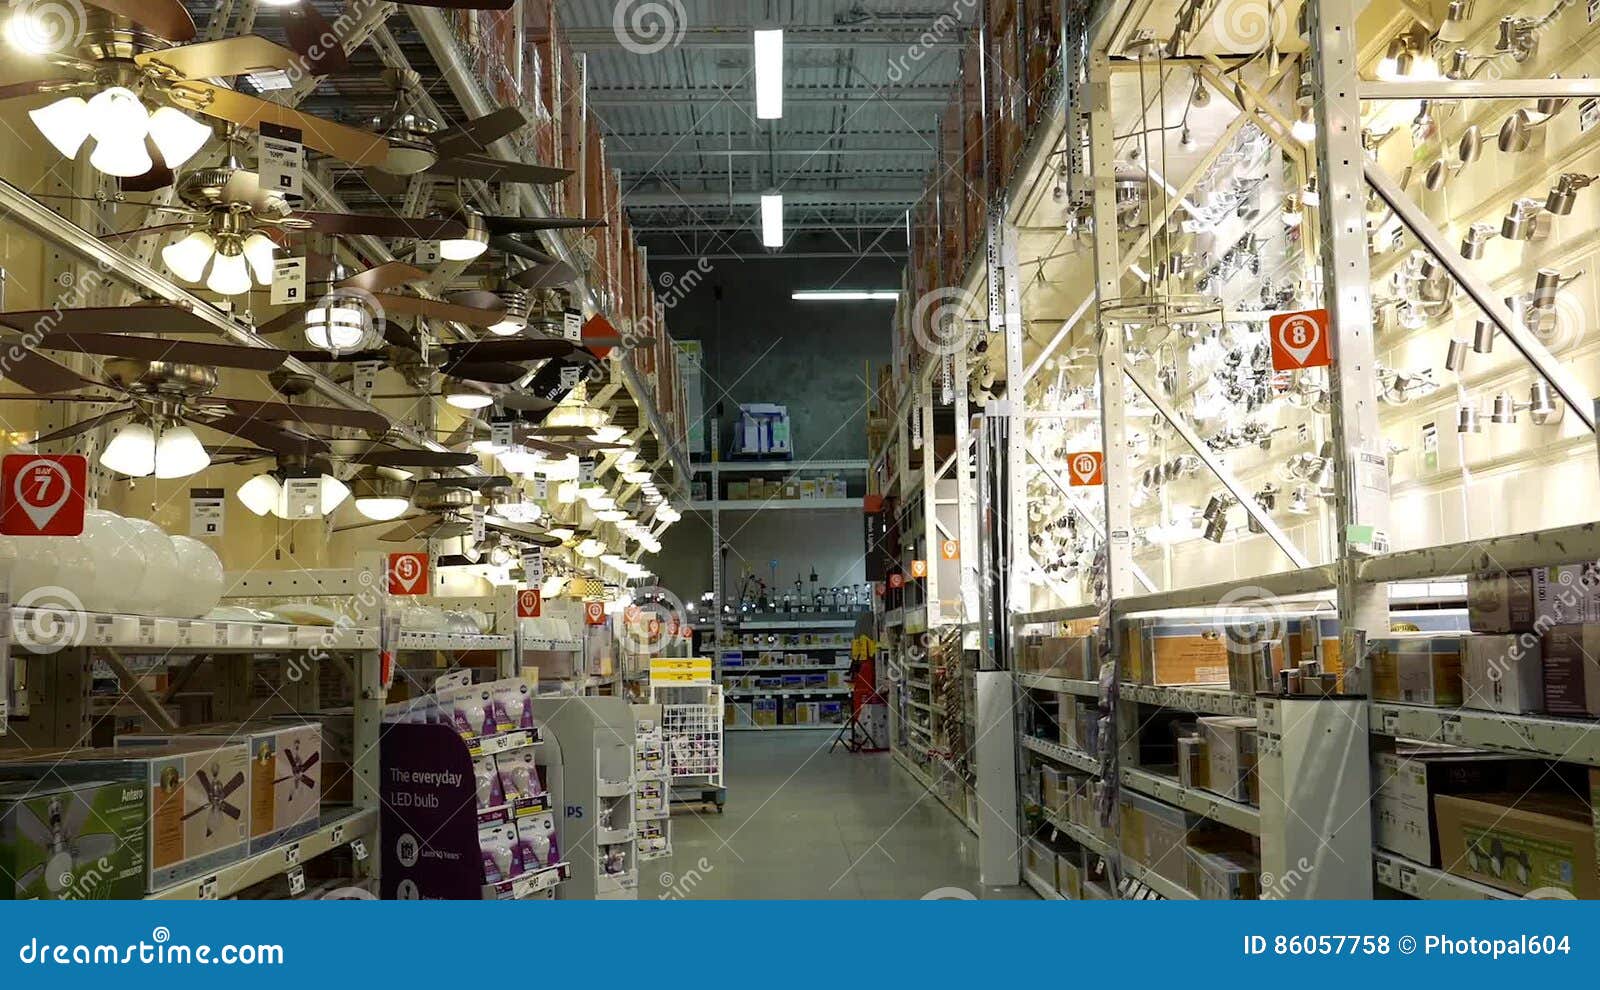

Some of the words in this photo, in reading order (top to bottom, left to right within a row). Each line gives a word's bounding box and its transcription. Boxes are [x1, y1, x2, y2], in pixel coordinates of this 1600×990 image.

[1293, 326, 1306, 344] 8
[35, 467, 52, 475] BAY
[1078, 459, 1092, 472] 10
[34, 476, 52, 500] 7
[403, 564, 413, 577] 9
[390, 768, 410, 782] The
[412, 769, 463, 788] everyday
[122, 788, 144, 802] Antero
[391, 791, 412, 806] LED
[414, 793, 439, 808] bulb
